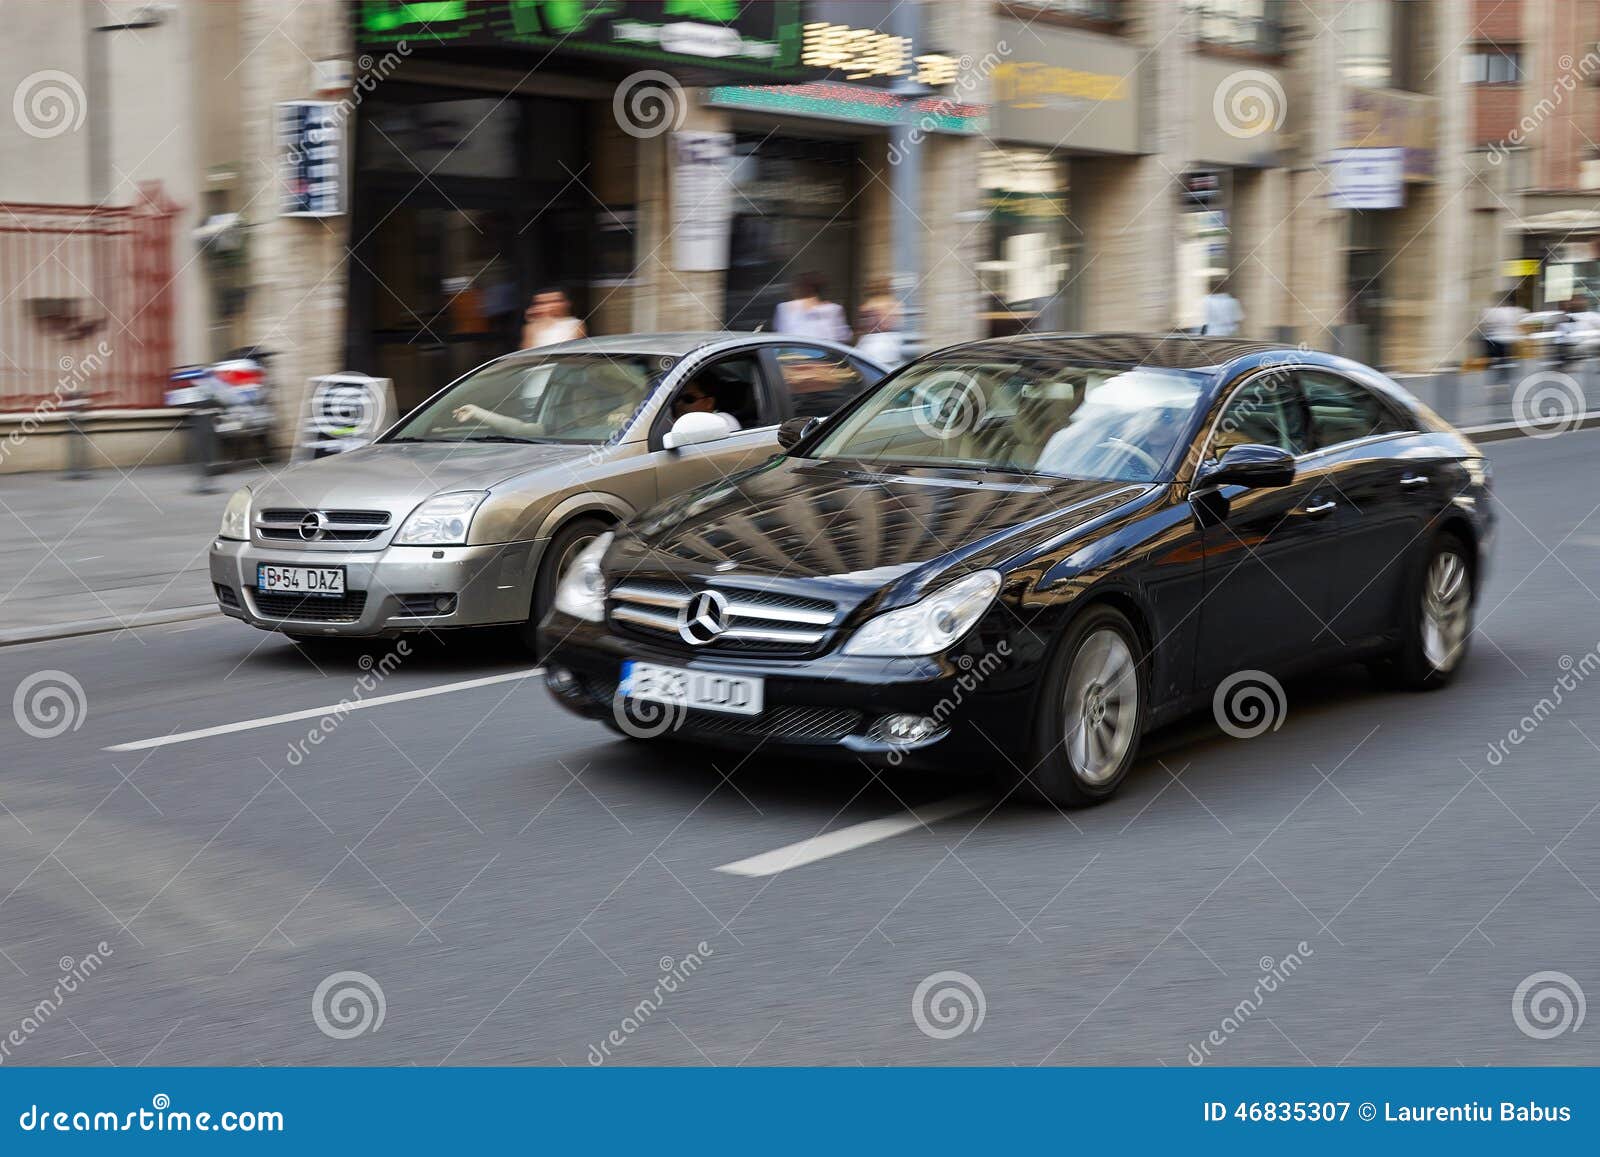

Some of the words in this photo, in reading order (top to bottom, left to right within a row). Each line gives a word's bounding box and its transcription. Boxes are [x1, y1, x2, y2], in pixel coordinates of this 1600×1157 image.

[267, 567, 277, 587] B
[282, 568, 300, 589] 54
[306, 569, 340, 590] DAZ
